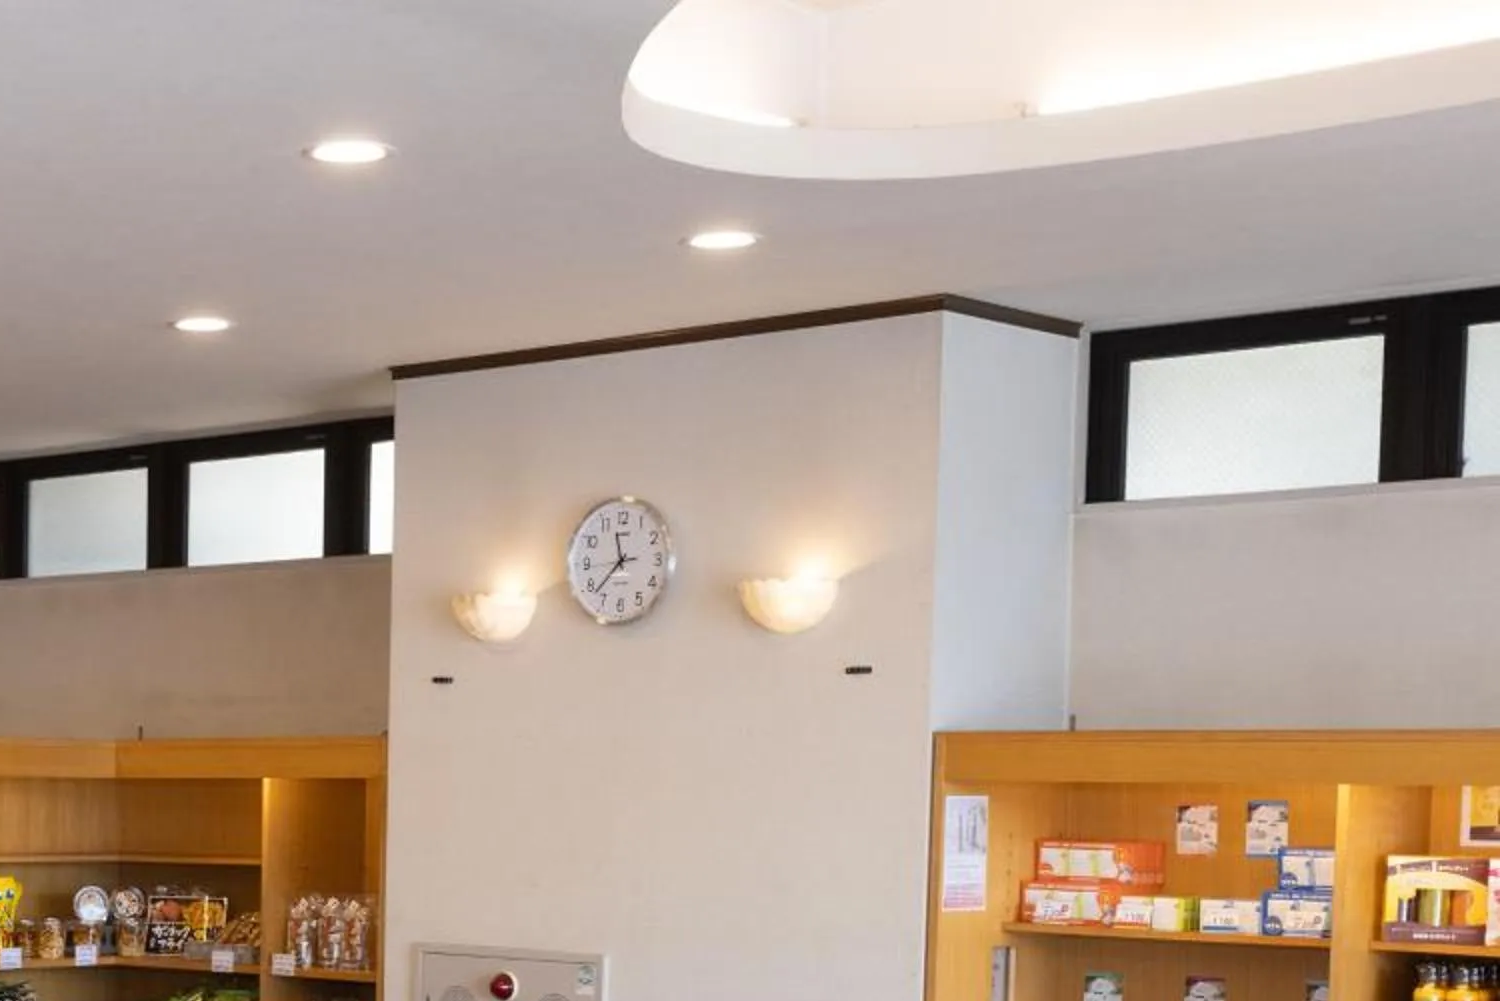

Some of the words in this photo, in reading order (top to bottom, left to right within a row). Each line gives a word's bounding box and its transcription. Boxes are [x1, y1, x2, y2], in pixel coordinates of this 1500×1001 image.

[601, 517, 611, 533] 11
[618, 512, 629, 525] 12
[639, 515, 644, 529] 1
[586, 535, 598, 549] 10
[650, 531, 659, 545] 2
[583, 556, 591, 571] 9
[655, 552, 663, 567] 3
[587, 578, 595, 593] 8
[647, 575, 657, 588] 4
[599, 593, 607, 607] 7
[616, 598, 625, 613] 6
[635, 591, 643, 606] 5
